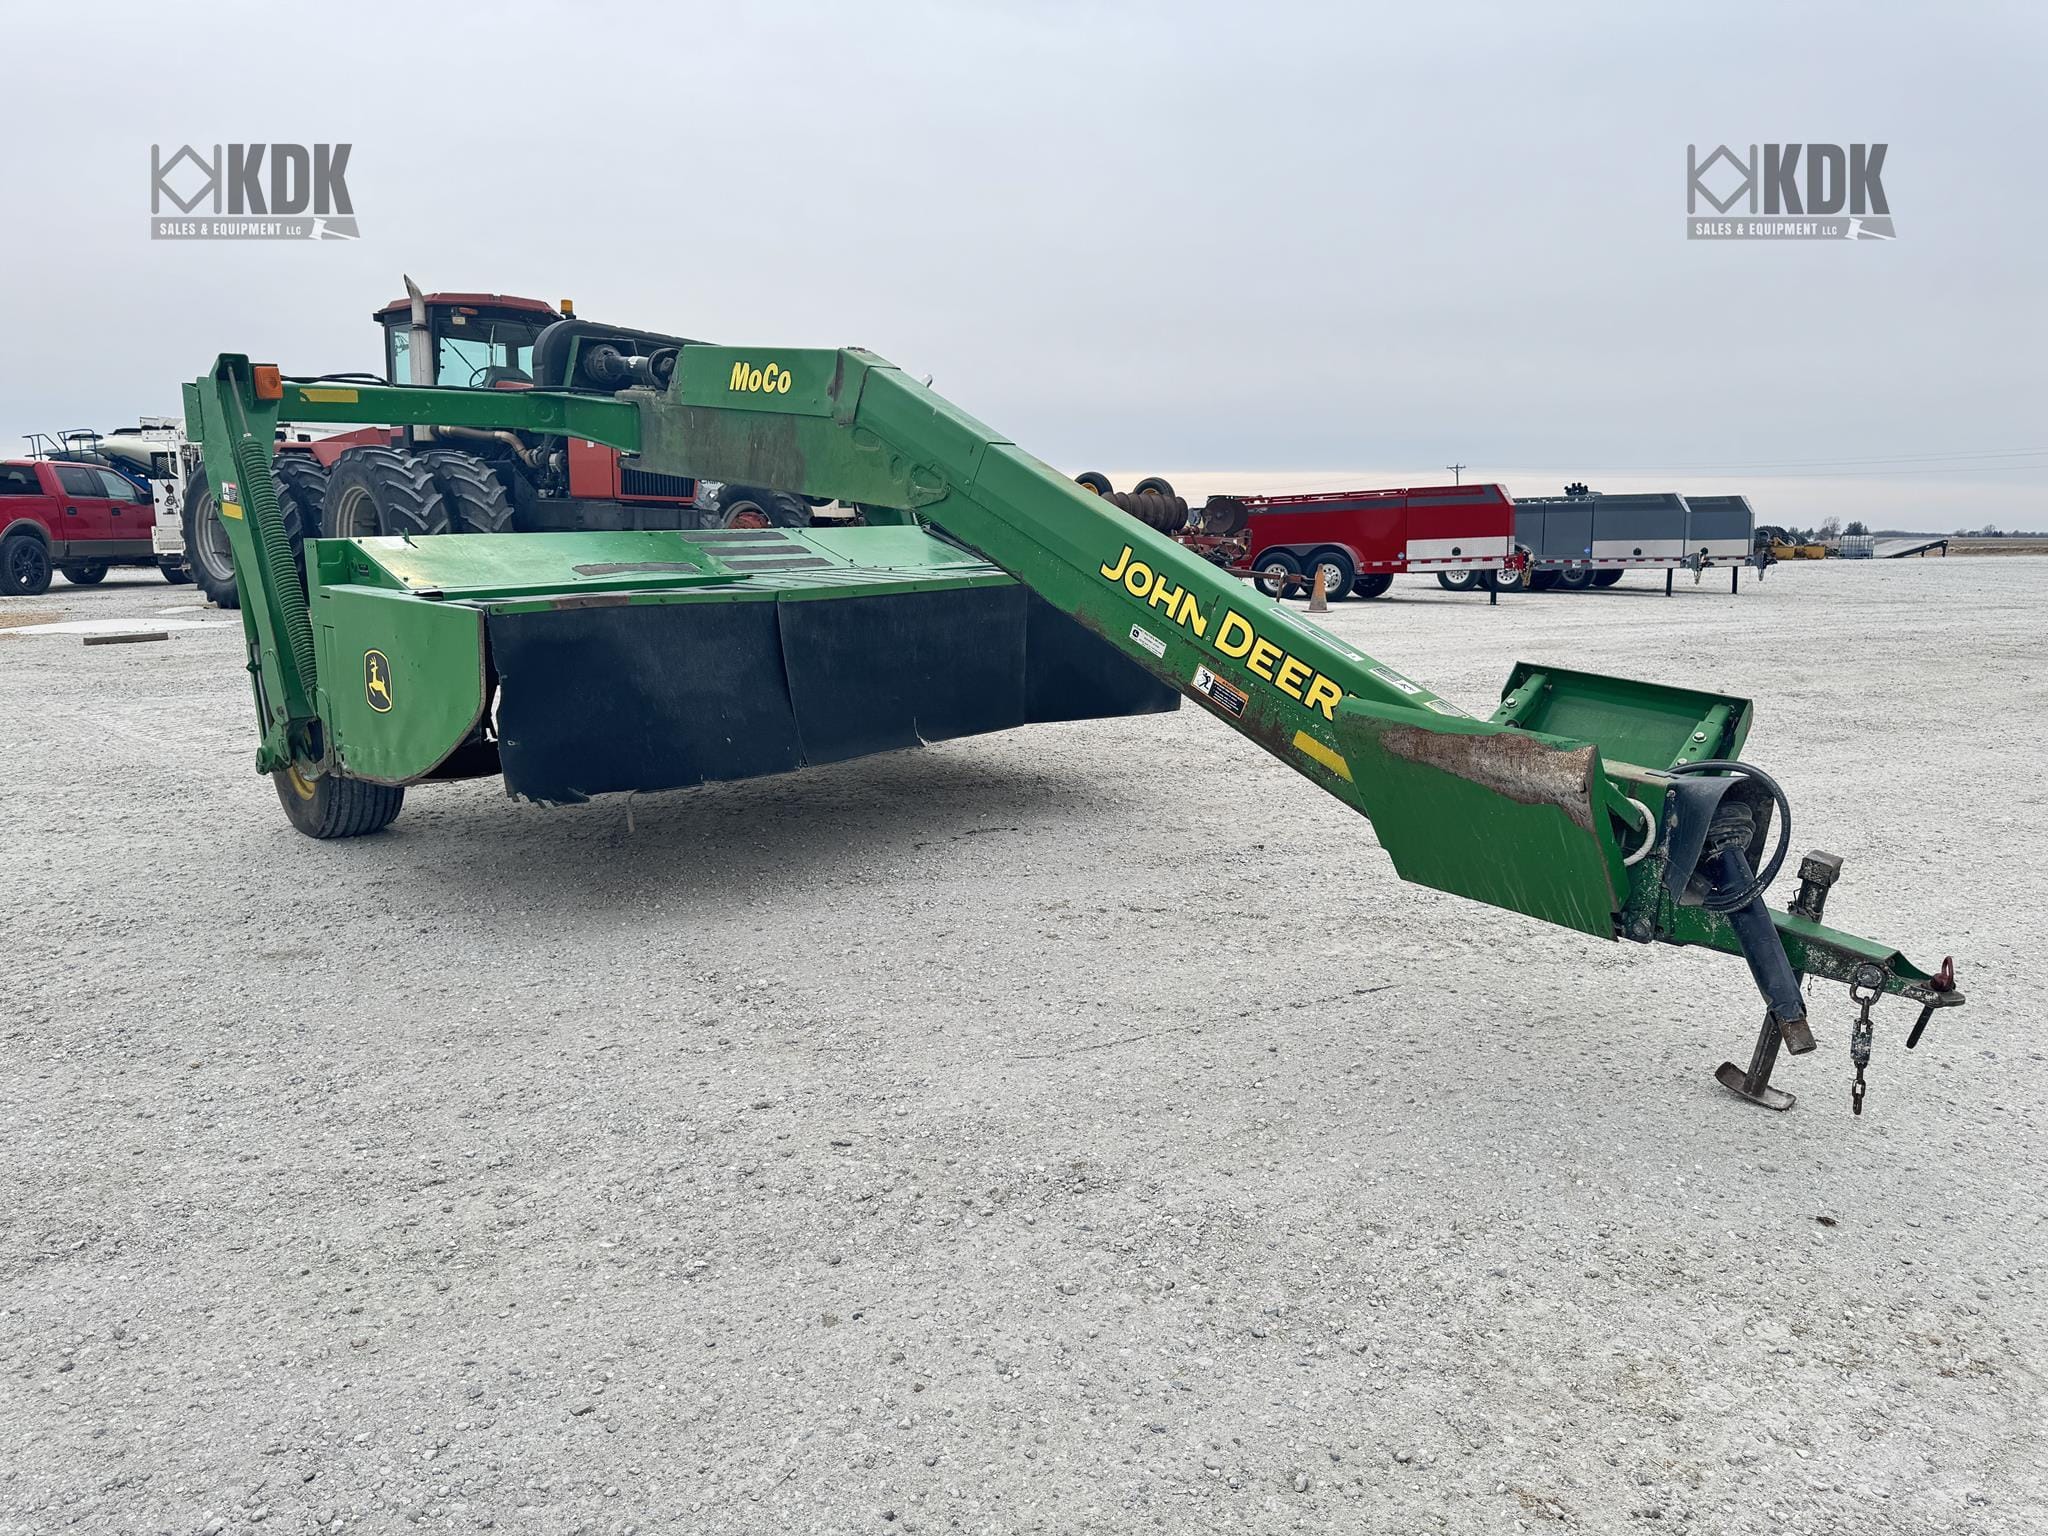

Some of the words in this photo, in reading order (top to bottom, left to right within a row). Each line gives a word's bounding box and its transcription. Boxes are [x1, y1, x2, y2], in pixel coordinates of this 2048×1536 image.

[729, 361, 792, 394] MoCo
[1100, 545, 1208, 637] JOHN
[1214, 610, 1359, 722] DEER
